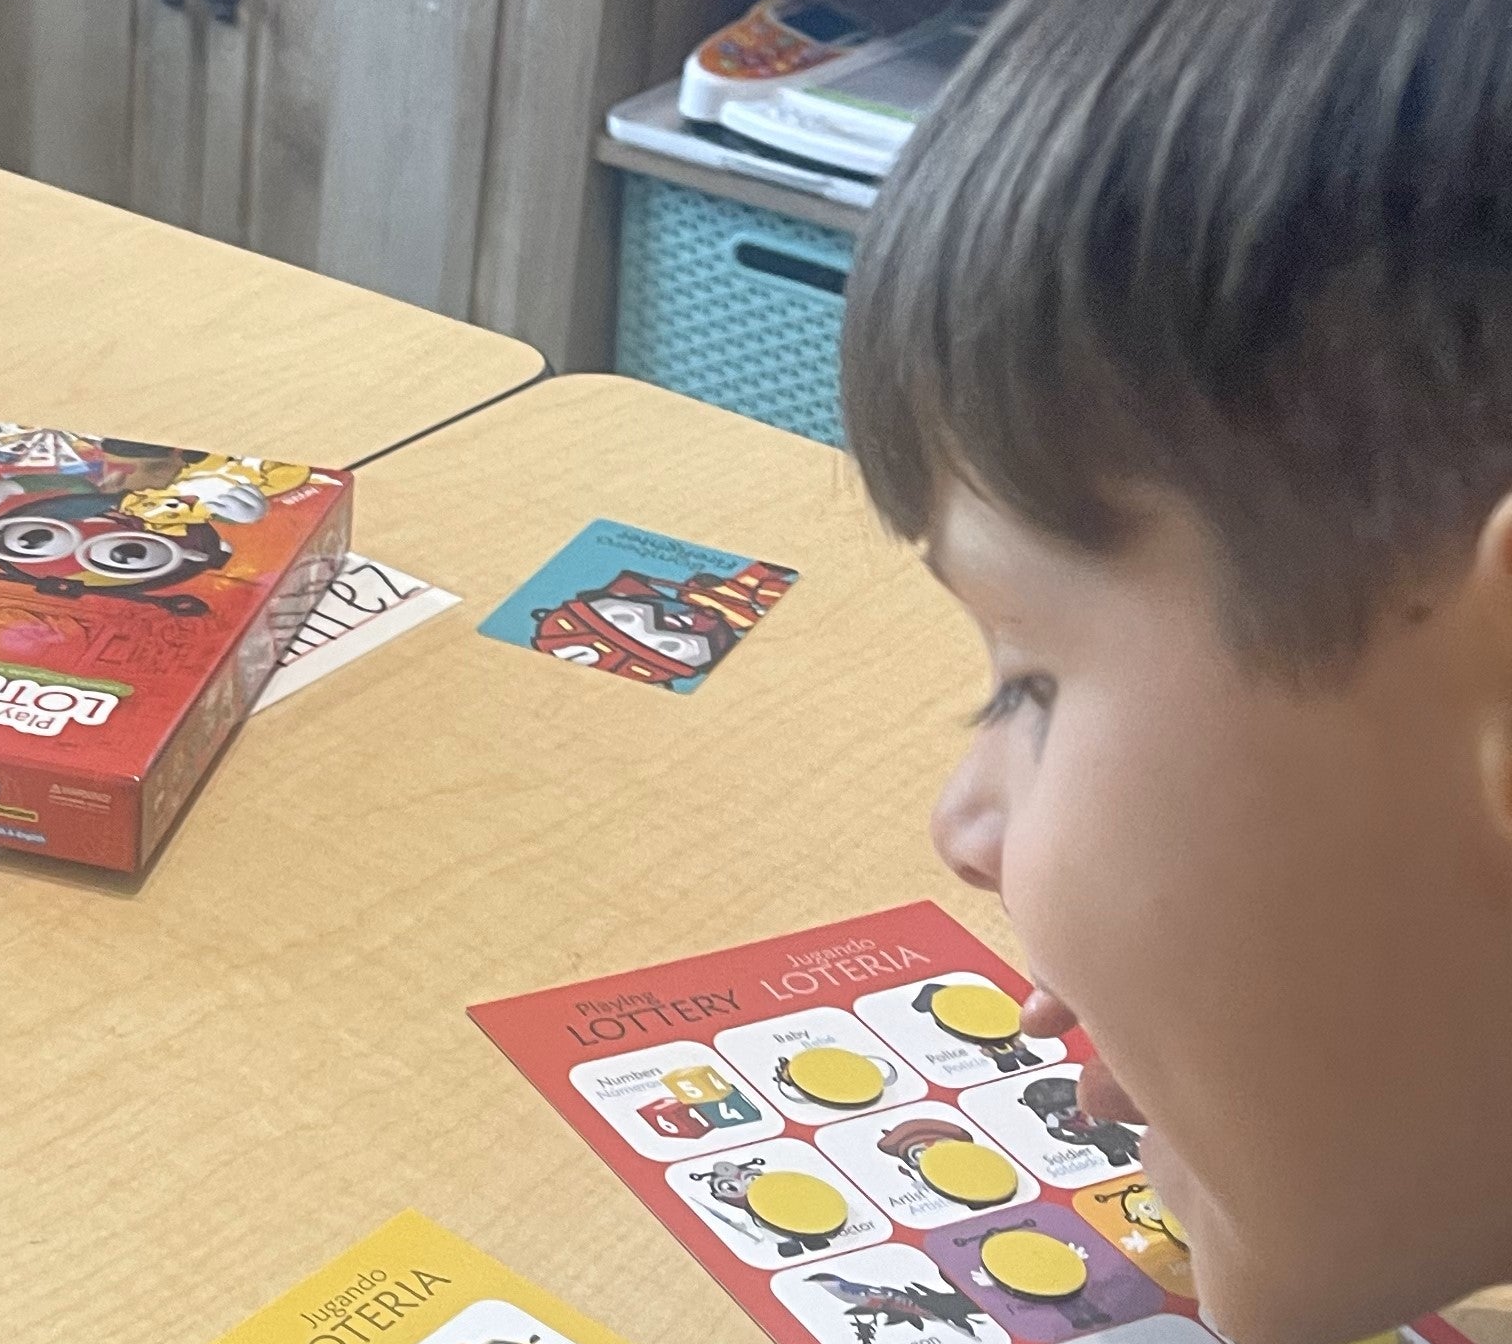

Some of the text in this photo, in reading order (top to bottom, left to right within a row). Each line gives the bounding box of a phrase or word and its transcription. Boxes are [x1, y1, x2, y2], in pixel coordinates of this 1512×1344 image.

[785, 936, 876, 970] Jugando
[759, 943, 931, 1002] LOTERIA
[574, 990, 658, 1016] Playing
[566, 988, 742, 1048] LOTTERY
[676, 1080, 704, 1099] 5
[655, 1114, 679, 1134] 6
[688, 1107, 709, 1128] 1
[839, 1220, 876, 1238] octor
[300, 1265, 388, 1330] Jugando
